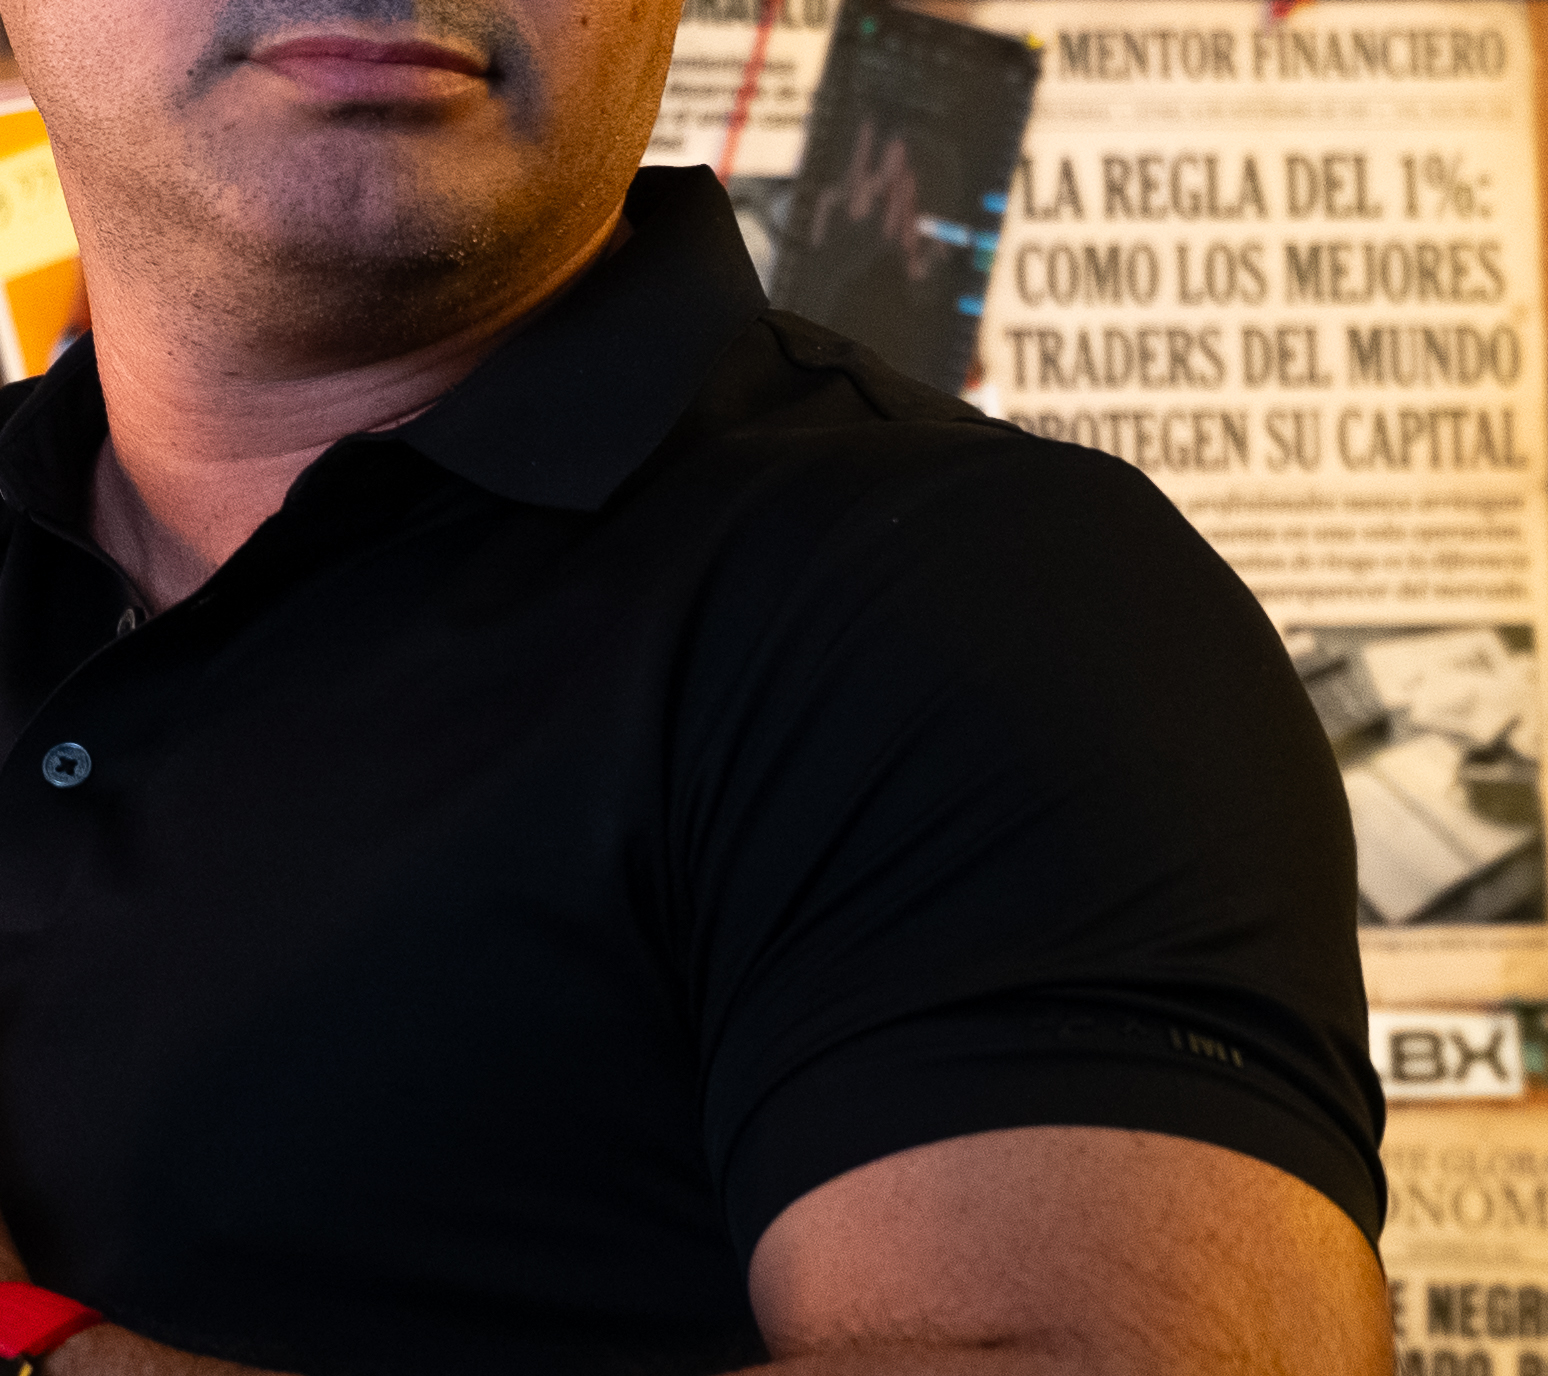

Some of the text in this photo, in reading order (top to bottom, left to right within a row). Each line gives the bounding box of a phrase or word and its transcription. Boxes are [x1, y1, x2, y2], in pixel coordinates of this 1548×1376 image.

[1058, 27, 1507, 83] MENTOR FINANCIERO
[1020, 153, 1080, 220] LA
[1103, 152, 1270, 220] REGLA
[1283, 153, 1384, 220] DEL
[1014, 241, 1506, 308] COMO LOS MEJORES
[1003, 324, 1523, 392] TRADERS DEL MUNDO
[1265, 408, 1326, 473] SU
[1338, 407, 1529, 472] CAPITAL
